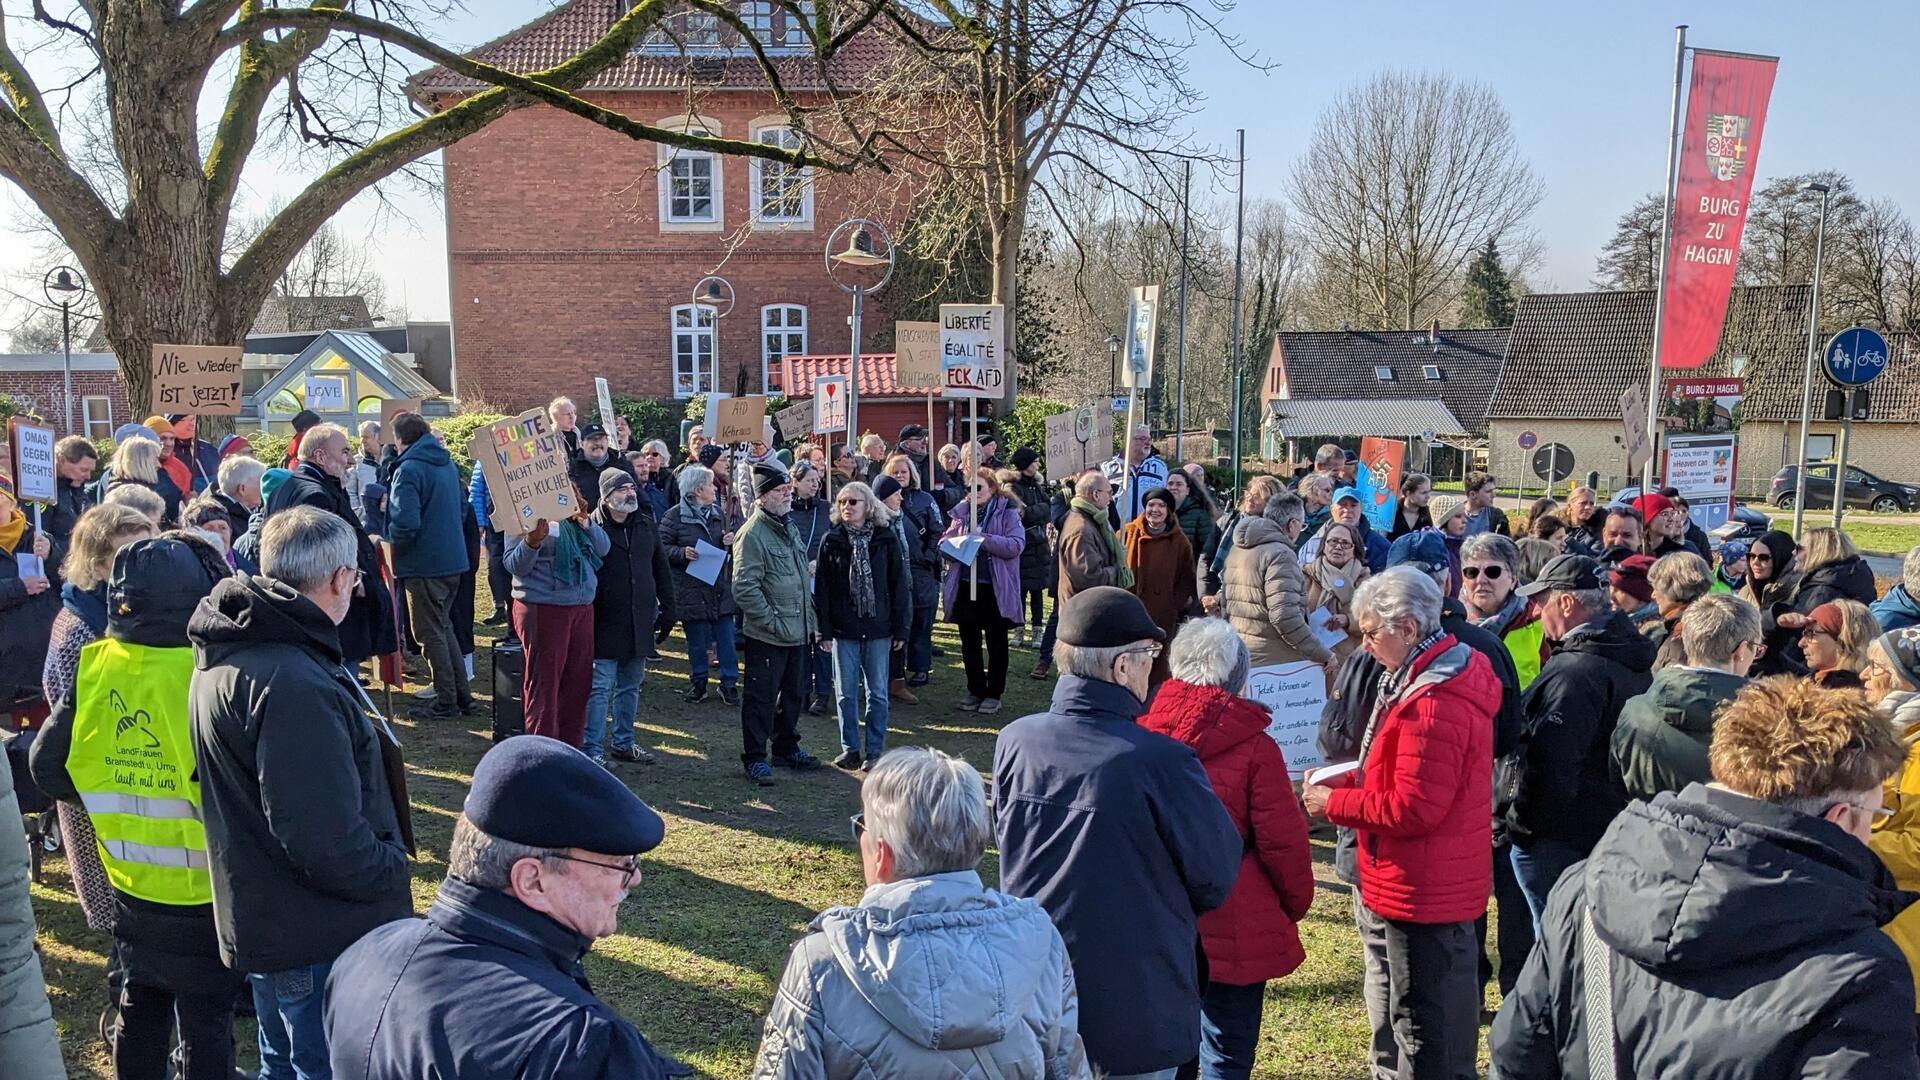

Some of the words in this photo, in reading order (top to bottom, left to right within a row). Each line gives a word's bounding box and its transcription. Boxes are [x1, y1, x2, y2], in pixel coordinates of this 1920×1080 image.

[1699, 196, 1741, 217] BURG
[1704, 223, 1725, 241] ZU
[1684, 245, 1734, 266] HAGEN
[945, 336, 995, 358] ÉGALITÉ
[947, 368, 972, 385] FCK
[976, 368, 1002, 387] AFD
[308, 386, 341, 398] LOVE
[1686, 385, 1705, 395] BURG
[1706, 385, 1716, 394] ZU
[1717, 384, 1739, 393] HAGEN
[821, 415, 845, 429] HETZE
[25, 431, 48, 446] OMAS
[496, 416, 546, 447] BUNTE
[23, 447, 51, 462] GEGEN
[21, 463, 53, 478] RECHTS
[506, 464, 534, 483] NICHT
[536, 455, 557, 474] NUR
[1255, 683, 1275, 698] Jetzt
[1278, 681, 1300, 692] können
[116, 746, 163, 758] LandFrauen
[105, 756, 146, 769] Bramstedt
[140, 773, 154, 788] mit
